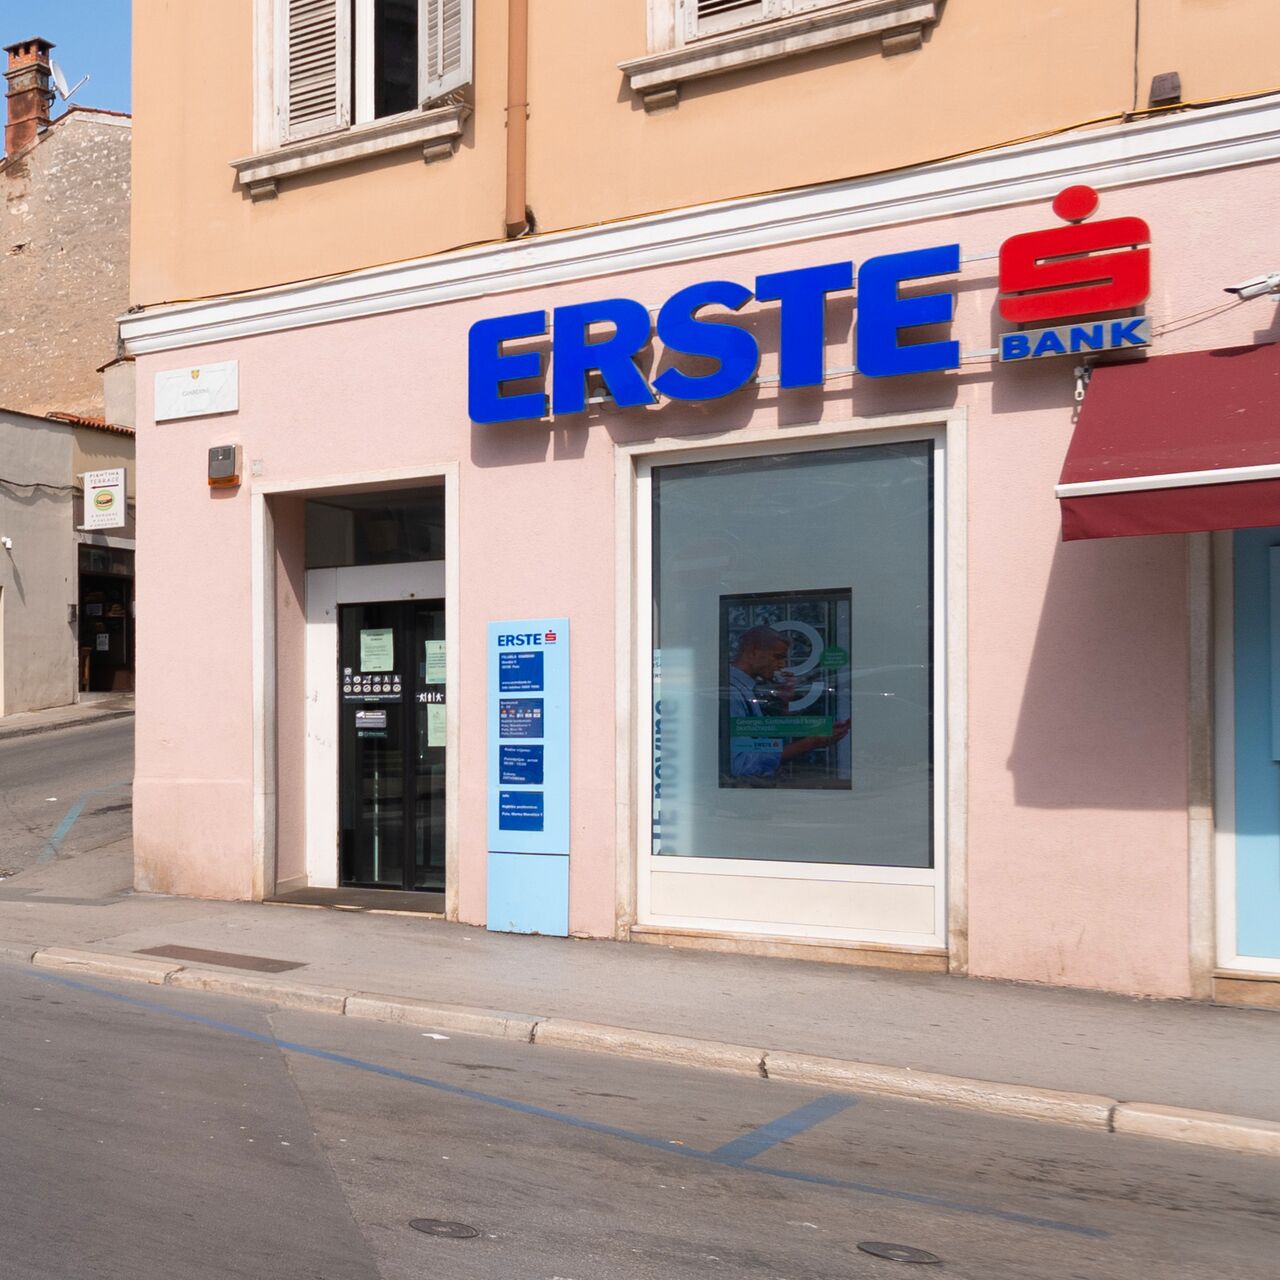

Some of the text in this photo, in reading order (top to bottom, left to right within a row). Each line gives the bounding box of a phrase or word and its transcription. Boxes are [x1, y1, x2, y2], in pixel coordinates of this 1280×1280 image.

[468, 243, 960, 425] ERSTE
[1002, 320, 1147, 361] BANK
[498, 633, 542, 647] ERSTE
